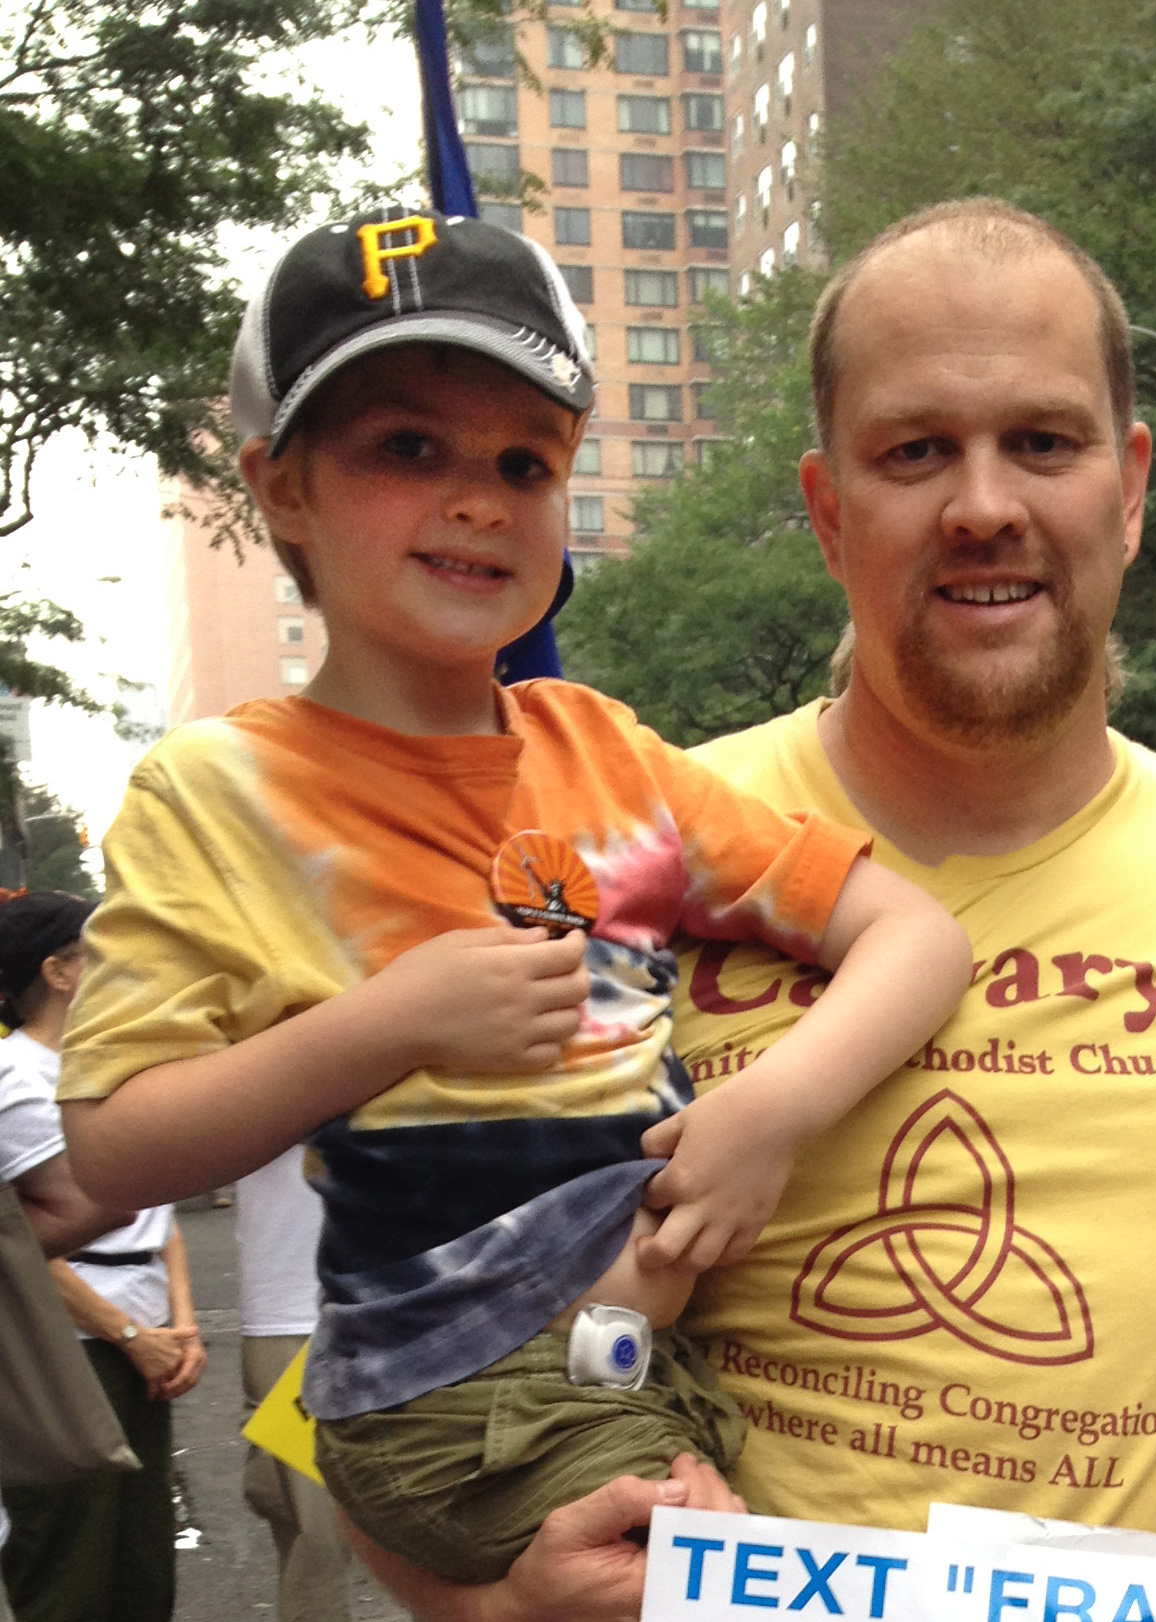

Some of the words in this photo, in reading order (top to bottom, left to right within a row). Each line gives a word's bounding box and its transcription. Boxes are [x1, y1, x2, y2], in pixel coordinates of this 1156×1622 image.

[356, 215, 437, 300] P
[906, 1037, 1054, 1077] hodist
[720, 1340, 927, 1421] Reconciling
[737, 1400, 838, 1446] where
[849, 1422, 898, 1459] all
[909, 1439, 1037, 1484] means
[1048, 1453, 1125, 1489] ALL
[671, 1536, 908, 1620] TEXT
